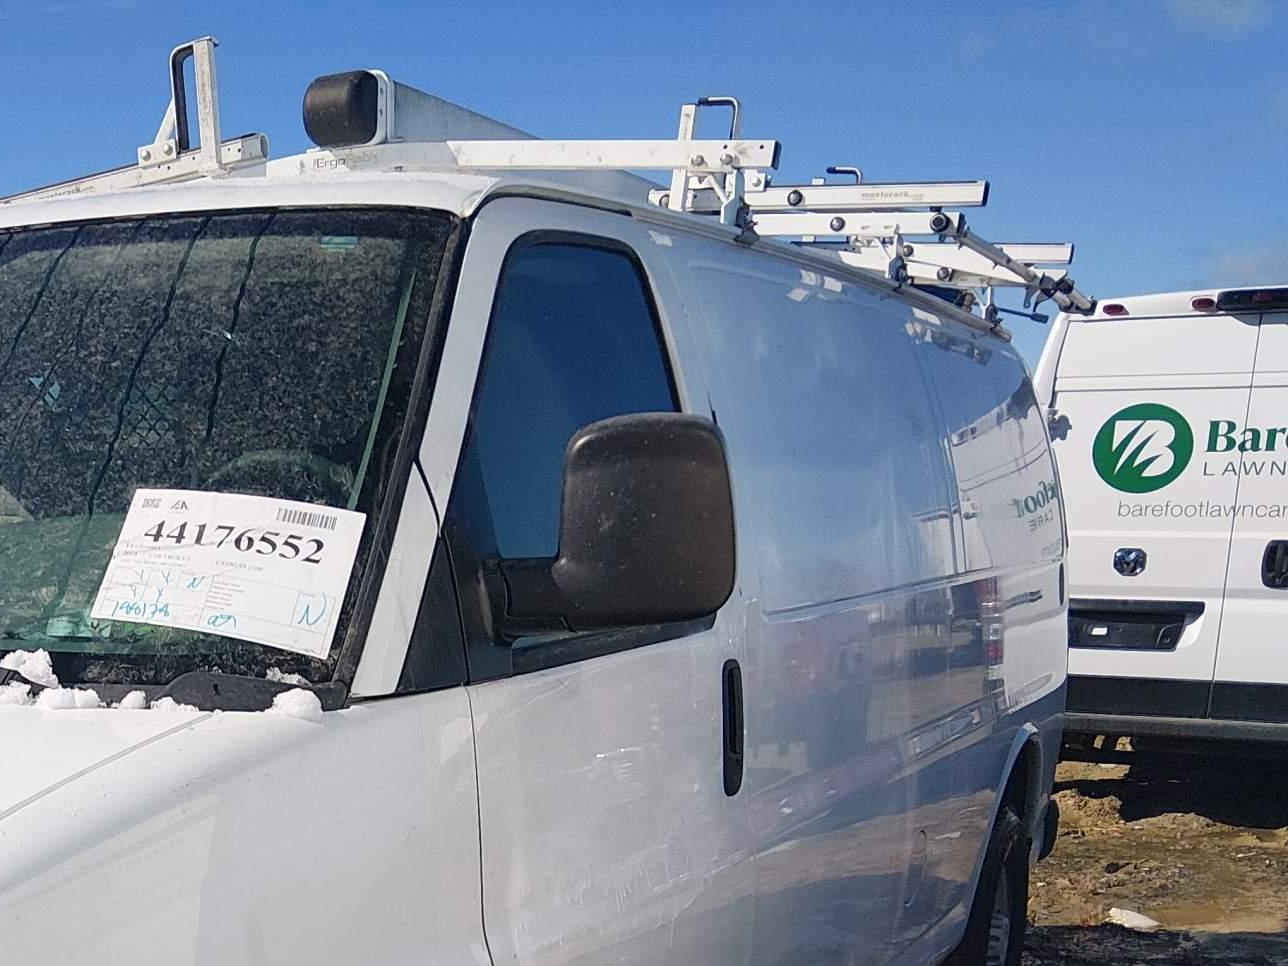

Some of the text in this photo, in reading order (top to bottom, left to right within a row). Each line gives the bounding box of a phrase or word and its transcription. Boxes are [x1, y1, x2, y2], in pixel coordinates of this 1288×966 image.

[1205, 420, 1288, 453] Bar
[1203, 461, 1288, 476] LAWN
[143, 519, 324, 564] 44176552
